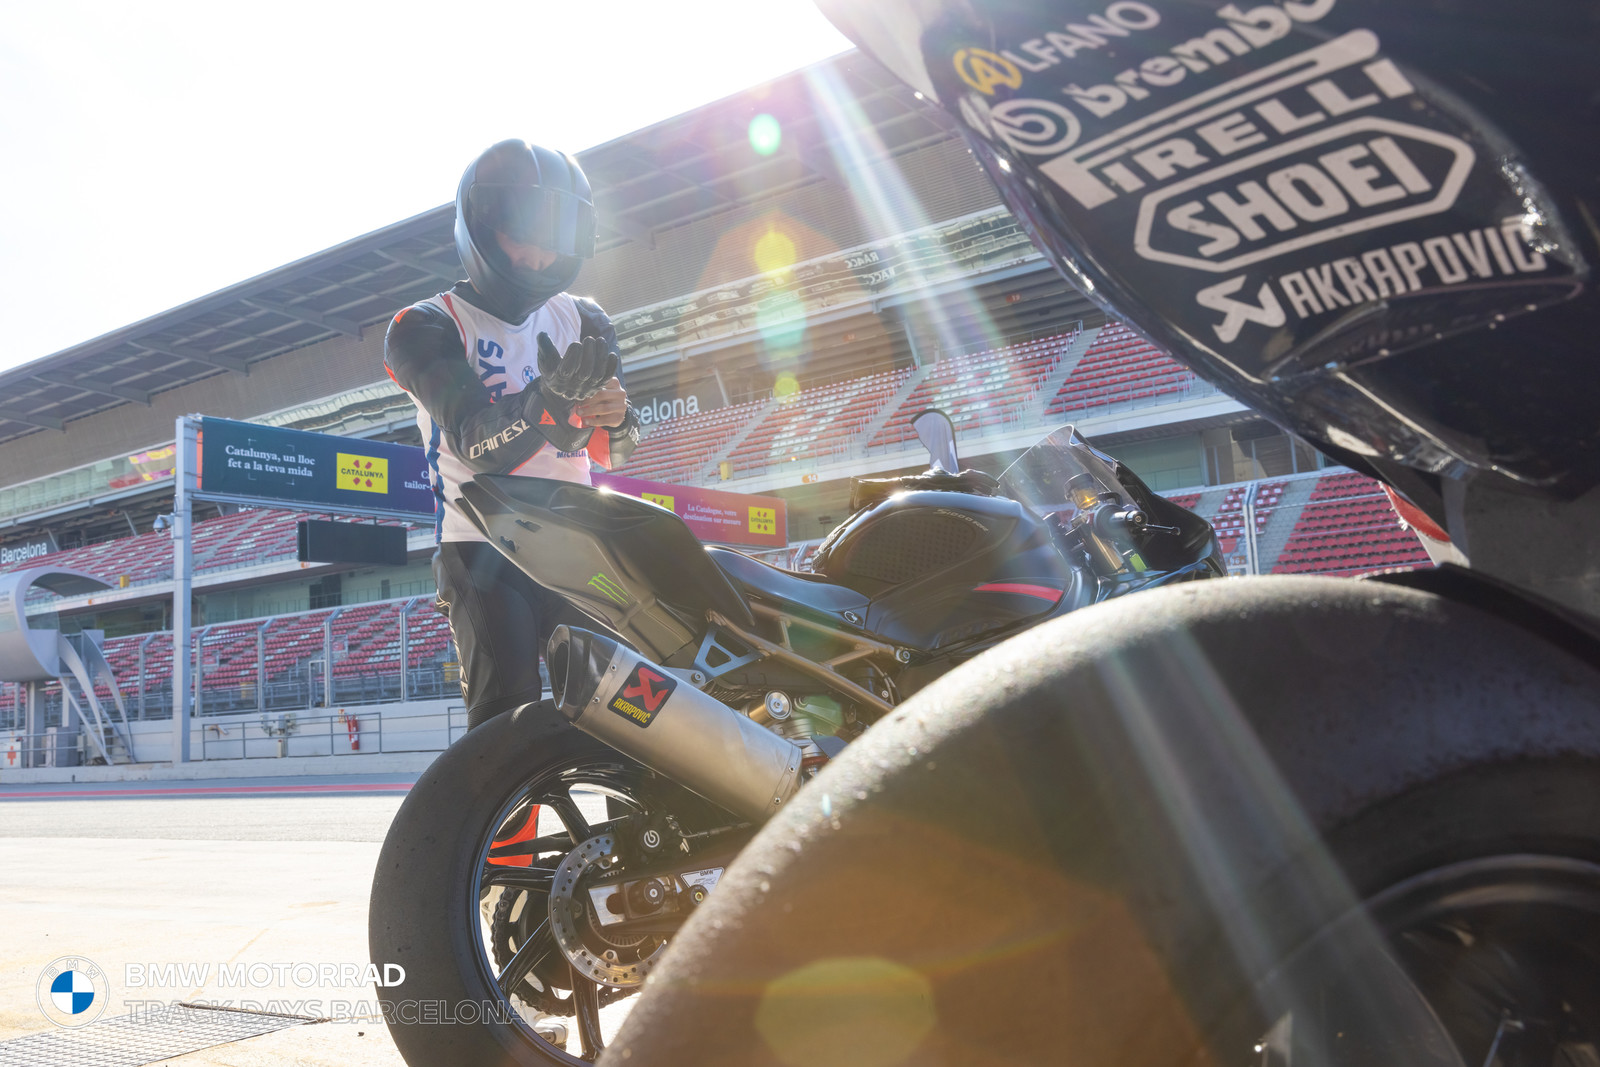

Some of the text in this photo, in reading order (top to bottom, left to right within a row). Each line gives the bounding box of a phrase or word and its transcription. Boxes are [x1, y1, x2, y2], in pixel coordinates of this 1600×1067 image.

[1039, 29, 1415, 210] PIRELLI
[1167, 137, 1432, 257] SHOEI
[225, 445, 316, 466] Catalunya, un lloc
[227, 458, 242, 469] fet
[253, 461, 263, 471] la
[265, 463, 286, 474] teva
[288, 466, 313, 477] mida
[341, 467, 384, 479] CATALUNYA
[1, 542, 47, 564] Barcelona
